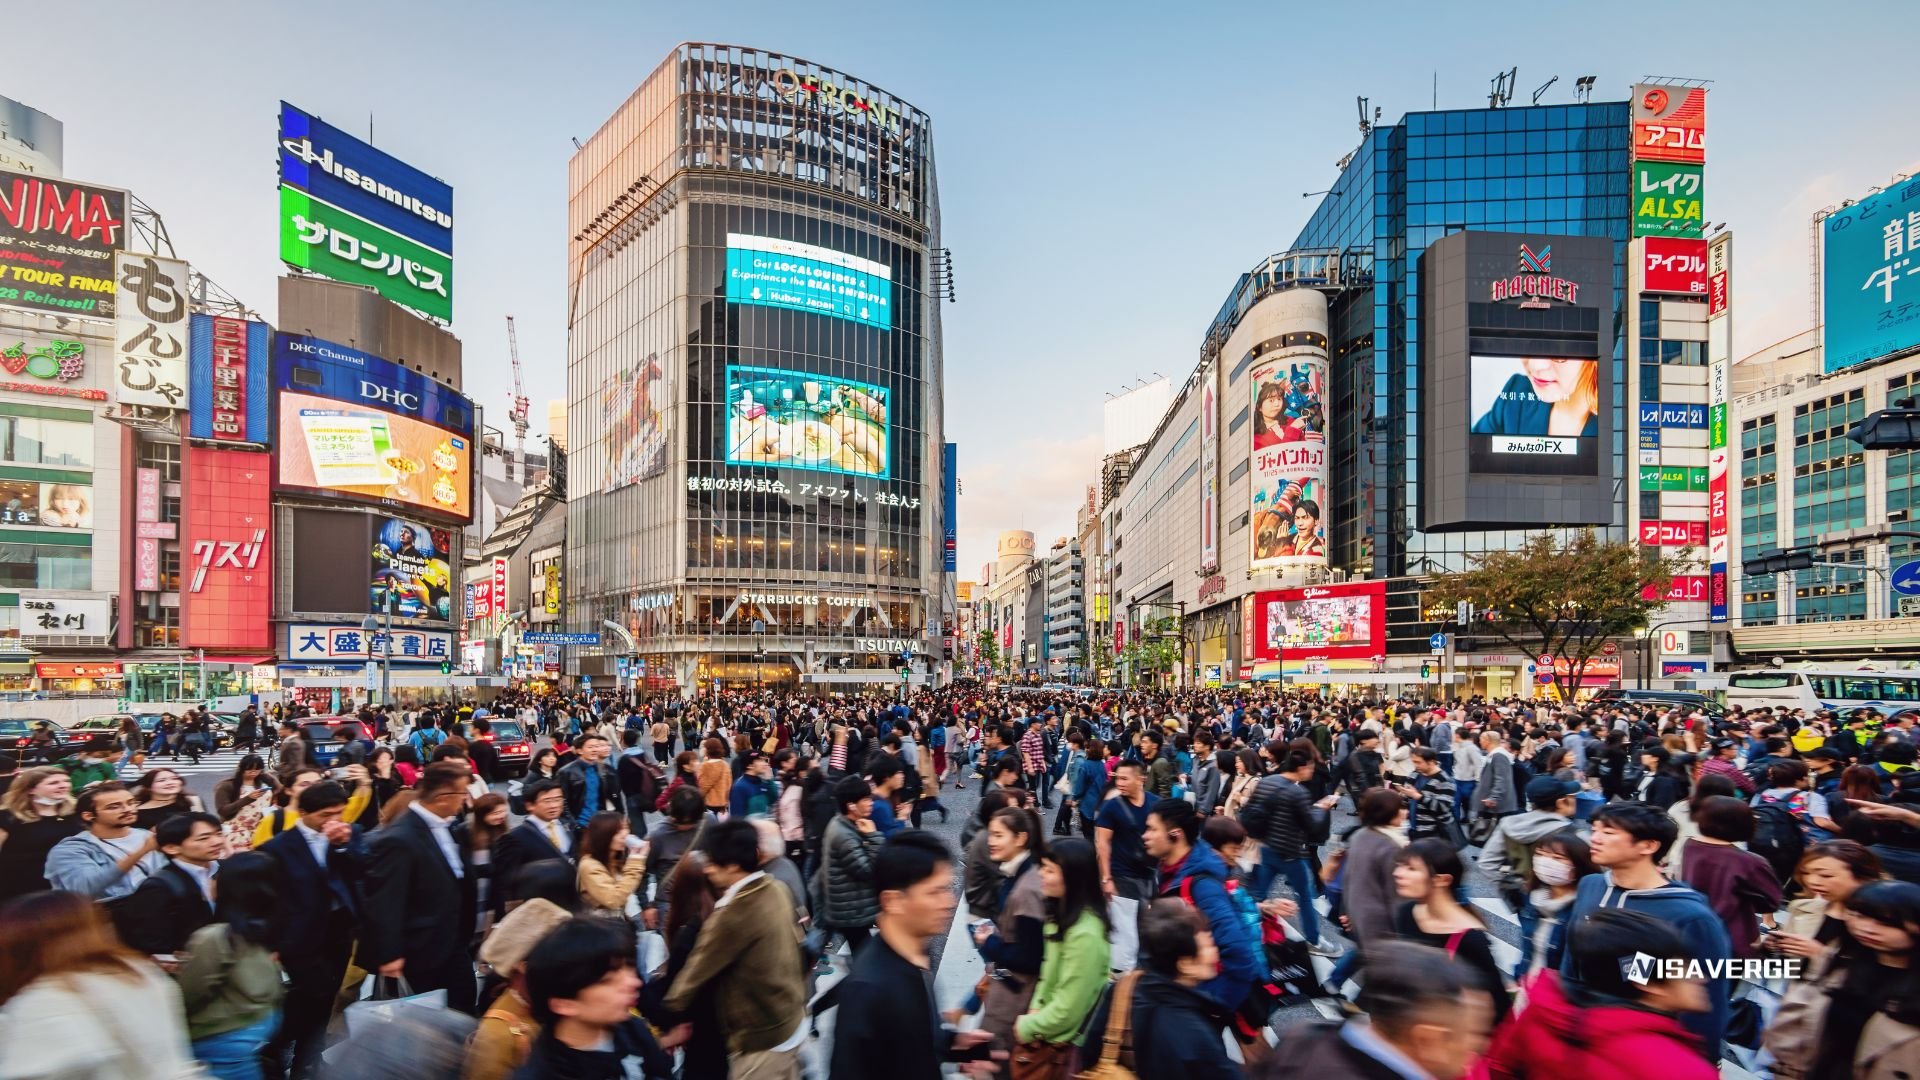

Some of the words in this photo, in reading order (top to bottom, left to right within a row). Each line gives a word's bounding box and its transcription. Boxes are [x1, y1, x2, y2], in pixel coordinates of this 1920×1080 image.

[1645, 125, 1704, 148] アコム
[1641, 170, 1700, 195] レイク
[1638, 197, 1701, 220] ALSA
[292, 215, 447, 298] サロンパス
[1647, 254, 1706, 273] アイフル
[11, 266, 65, 289] TOUR
[731, 269, 787, 284] Experience
[790, 276, 805, 287] the
[808, 279, 837, 293] REAL
[754, 259, 772, 270] Get
[774, 261, 812, 276] LOCAL
[814, 268, 857, 287] GUIDES
[1492, 275, 1579, 305] MAGNET
[1690, 281, 1706, 292] 8F
[1713, 282, 1724, 313] アイフル
[806, 298, 835, 311] Japan
[120, 257, 186, 404] もんじゃ
[289, 341, 317, 355] DHC
[318, 346, 364, 366] Channel
[212, 318, 241, 434] 三千里薬品
[1714, 364, 1723, 404] レオパレス21
[360, 380, 418, 411] DHC
[1641, 409, 1703, 425] レオパレス21
[1713, 406, 1722, 422] レイク
[1508, 440, 1563, 454] みんなのFX
[1257, 447, 1324, 471] ジャパンカップ
[1640, 472, 1659, 481] レイク
[1662, 473, 1683, 481] ALSA
[382, 498, 399, 506] DHC
[1712, 490, 1725, 518] アコム
[1645, 526, 1687, 540] アコム
[945, 528, 956, 564] SEIBU
[189, 528, 268, 593] クスリ
[390, 559, 436, 578] Planets
[397, 553, 425, 565] teamLab
[495, 562, 506, 603] カラオケ
[1667, 588, 1682, 598] 入口
[1713, 572, 1724, 607] PROMISE
[741, 594, 819, 606] STARBUCKS
[826, 596, 871, 608] COFFEE
[1902, 605, 1909, 613] 8
[37, 612, 85, 631] 松川
[299, 632, 449, 657] 大盛堂書店
[857, 638, 920, 654] TSUTAYA
[1664, 665, 1692, 673] PROMISE
